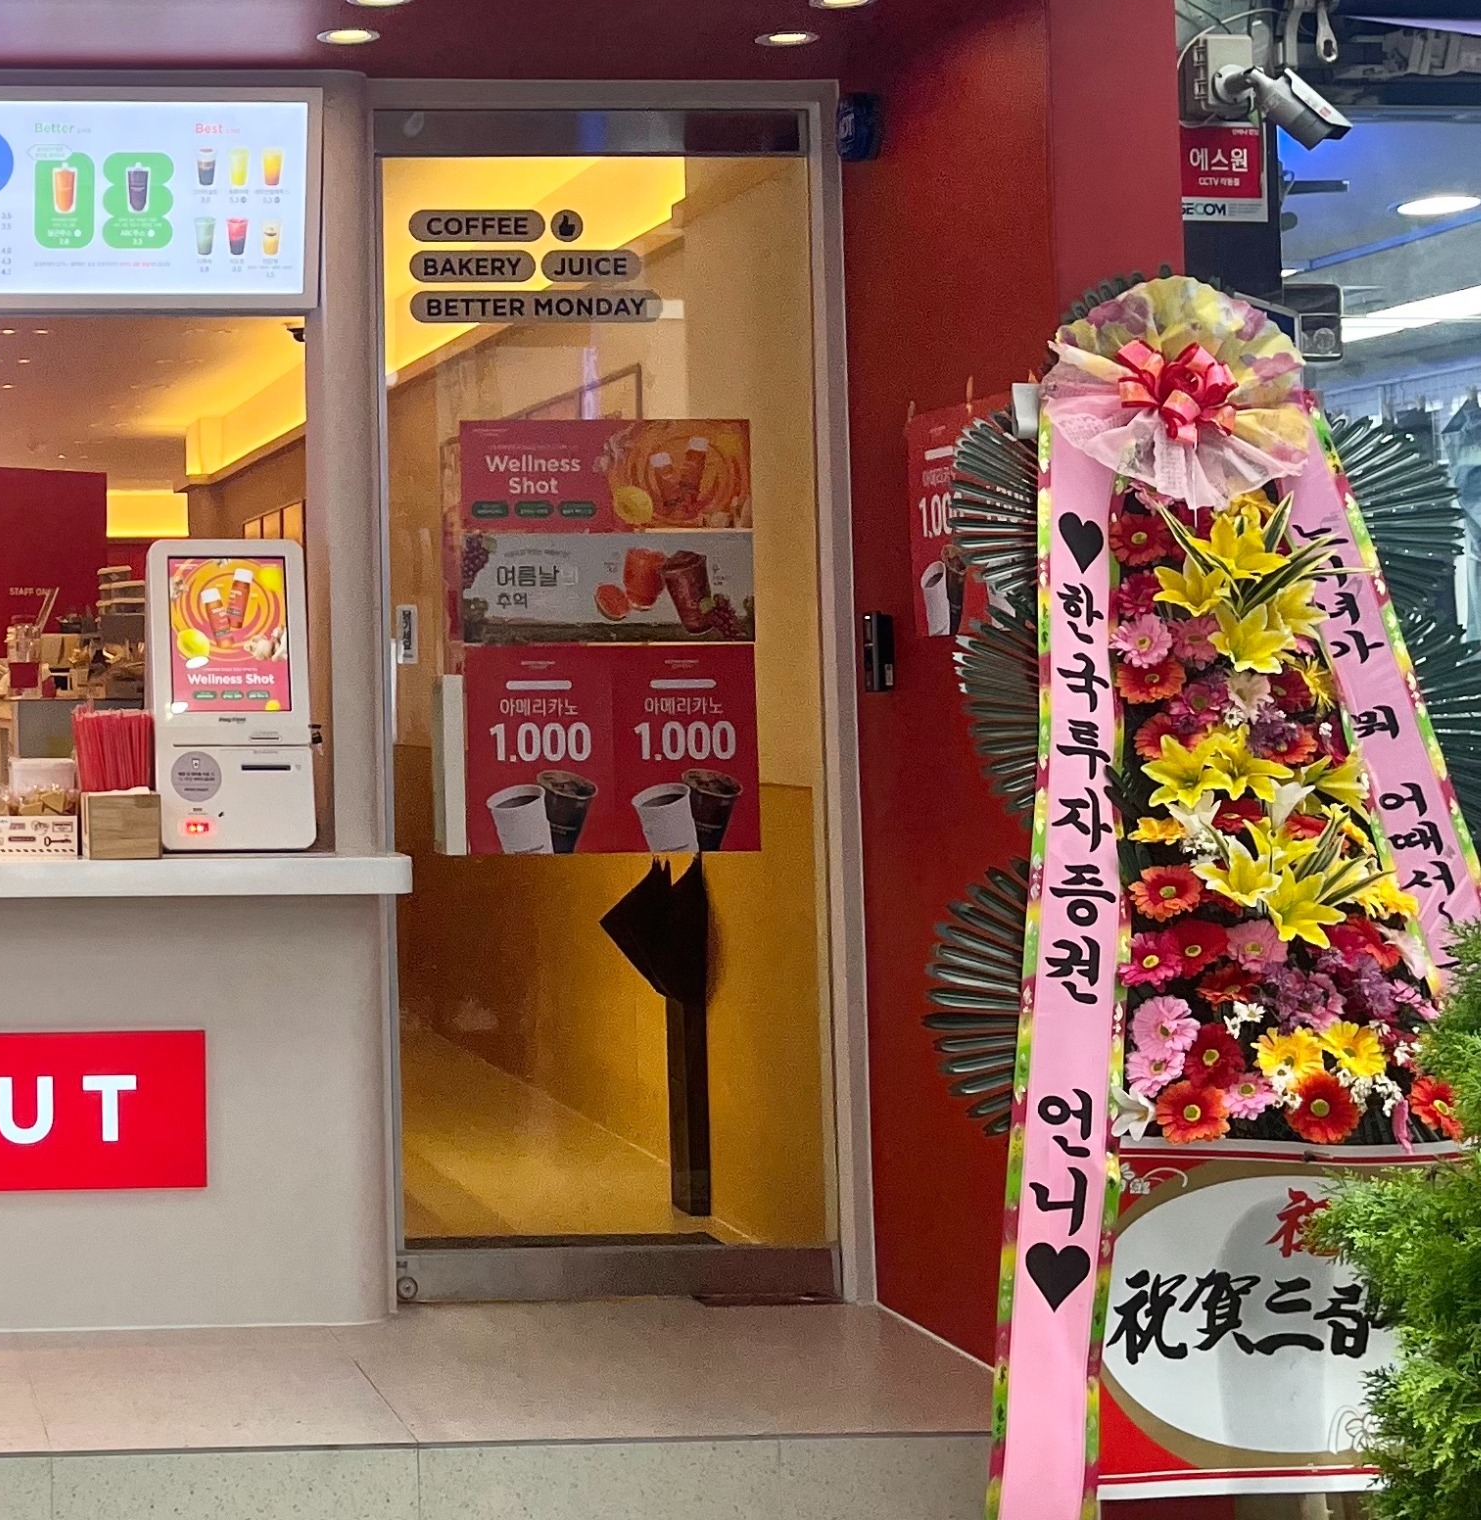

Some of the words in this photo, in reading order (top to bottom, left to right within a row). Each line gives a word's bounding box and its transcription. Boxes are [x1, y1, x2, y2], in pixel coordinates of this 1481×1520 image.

[34, 122, 75, 134] Better
[194, 122, 223, 134] Best
[1189, 147, 1249, 172] 에스원
[426, 216, 529, 236] COFFEE
[423, 257, 522, 276] BAKERY
[553, 257, 628, 276] JUICE
[426, 298, 525, 316] BETTER
[534, 297, 647, 316] MONDAY
[485, 453, 582, 473] Wellness
[508, 476, 559, 495] Shot
[8, 586, 34, 597] STAFF
[186, 673, 242, 686] Wellness
[245, 673, 276, 686] Shot
[499, 696, 580, 717] 아메리카노
[643, 696, 725, 716] 아메리카노
[489, 721, 592, 763] 1.000
[633, 720, 737, 762] 1.000
[1045, 583, 1117, 1006] 한국투자증권
[1029, 1087, 1093, 1238] 언니
